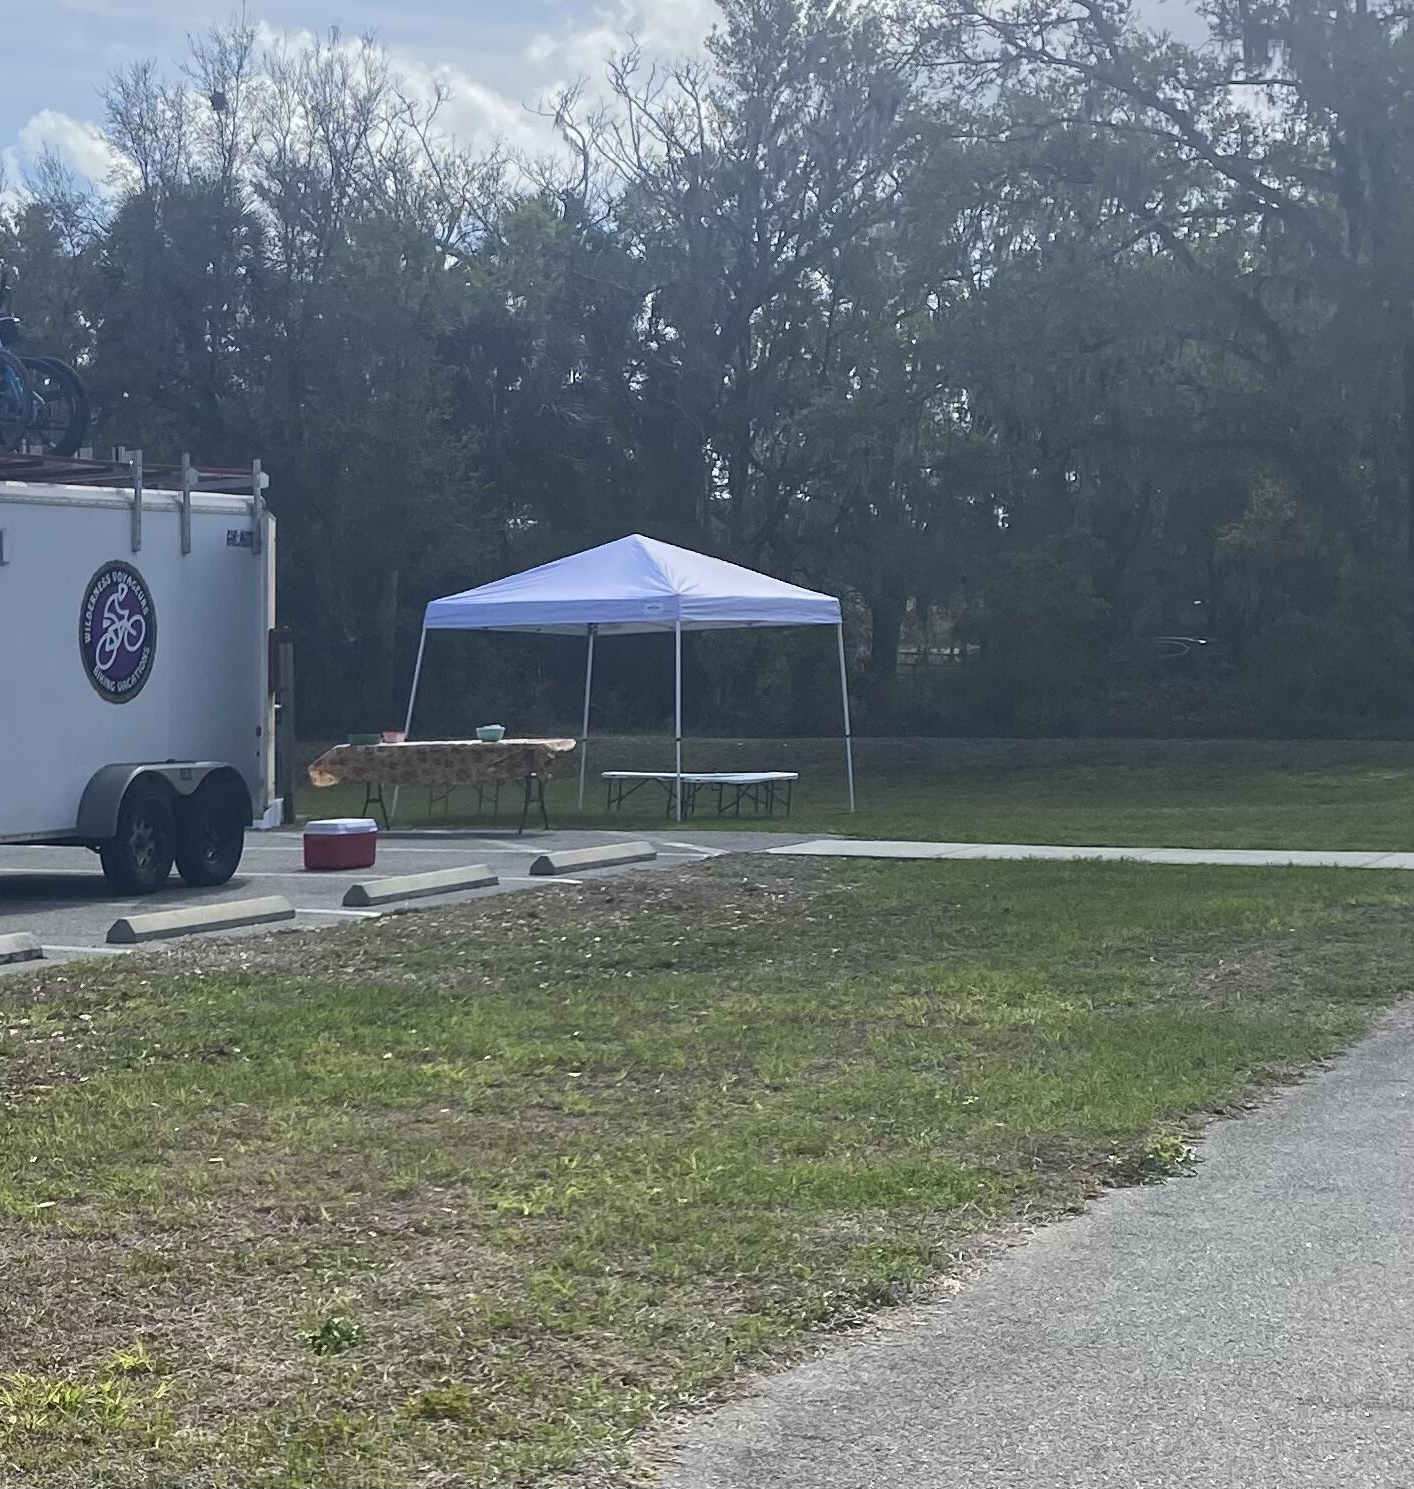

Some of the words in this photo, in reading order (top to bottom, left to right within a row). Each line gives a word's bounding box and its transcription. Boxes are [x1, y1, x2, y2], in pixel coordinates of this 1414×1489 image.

[84, 573, 111, 644] WILDERNESS
[111, 571, 149, 616] VOYAGEURS
[92, 665, 116, 692] BIKING
[116, 646, 151, 692] VACATIONS
